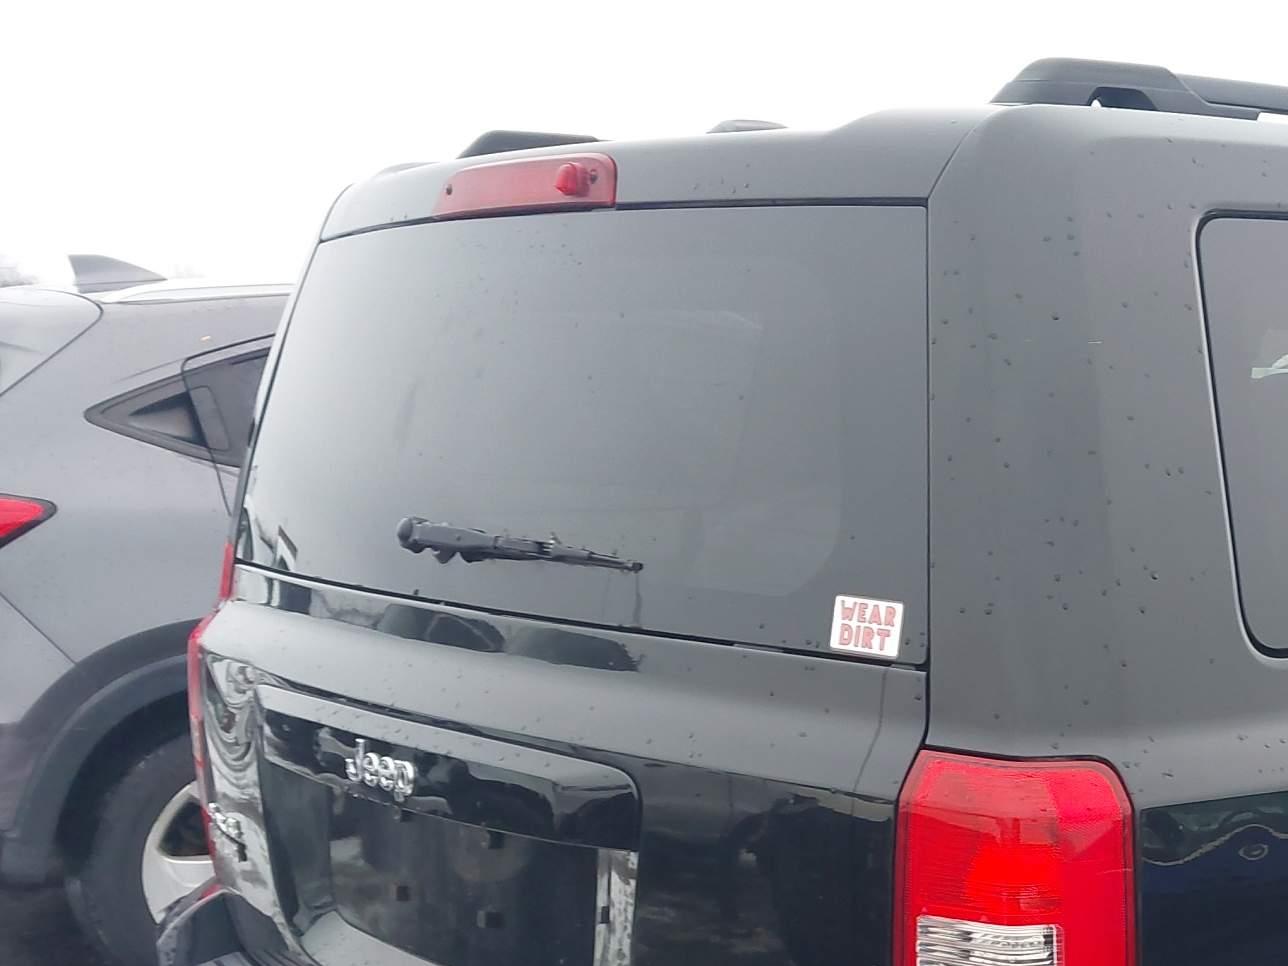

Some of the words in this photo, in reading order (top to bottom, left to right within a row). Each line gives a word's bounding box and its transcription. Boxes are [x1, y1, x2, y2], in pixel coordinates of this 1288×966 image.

[841, 599, 896, 627] WEAR
[838, 623, 890, 651] DIRT
[344, 738, 415, 802] Jeep
